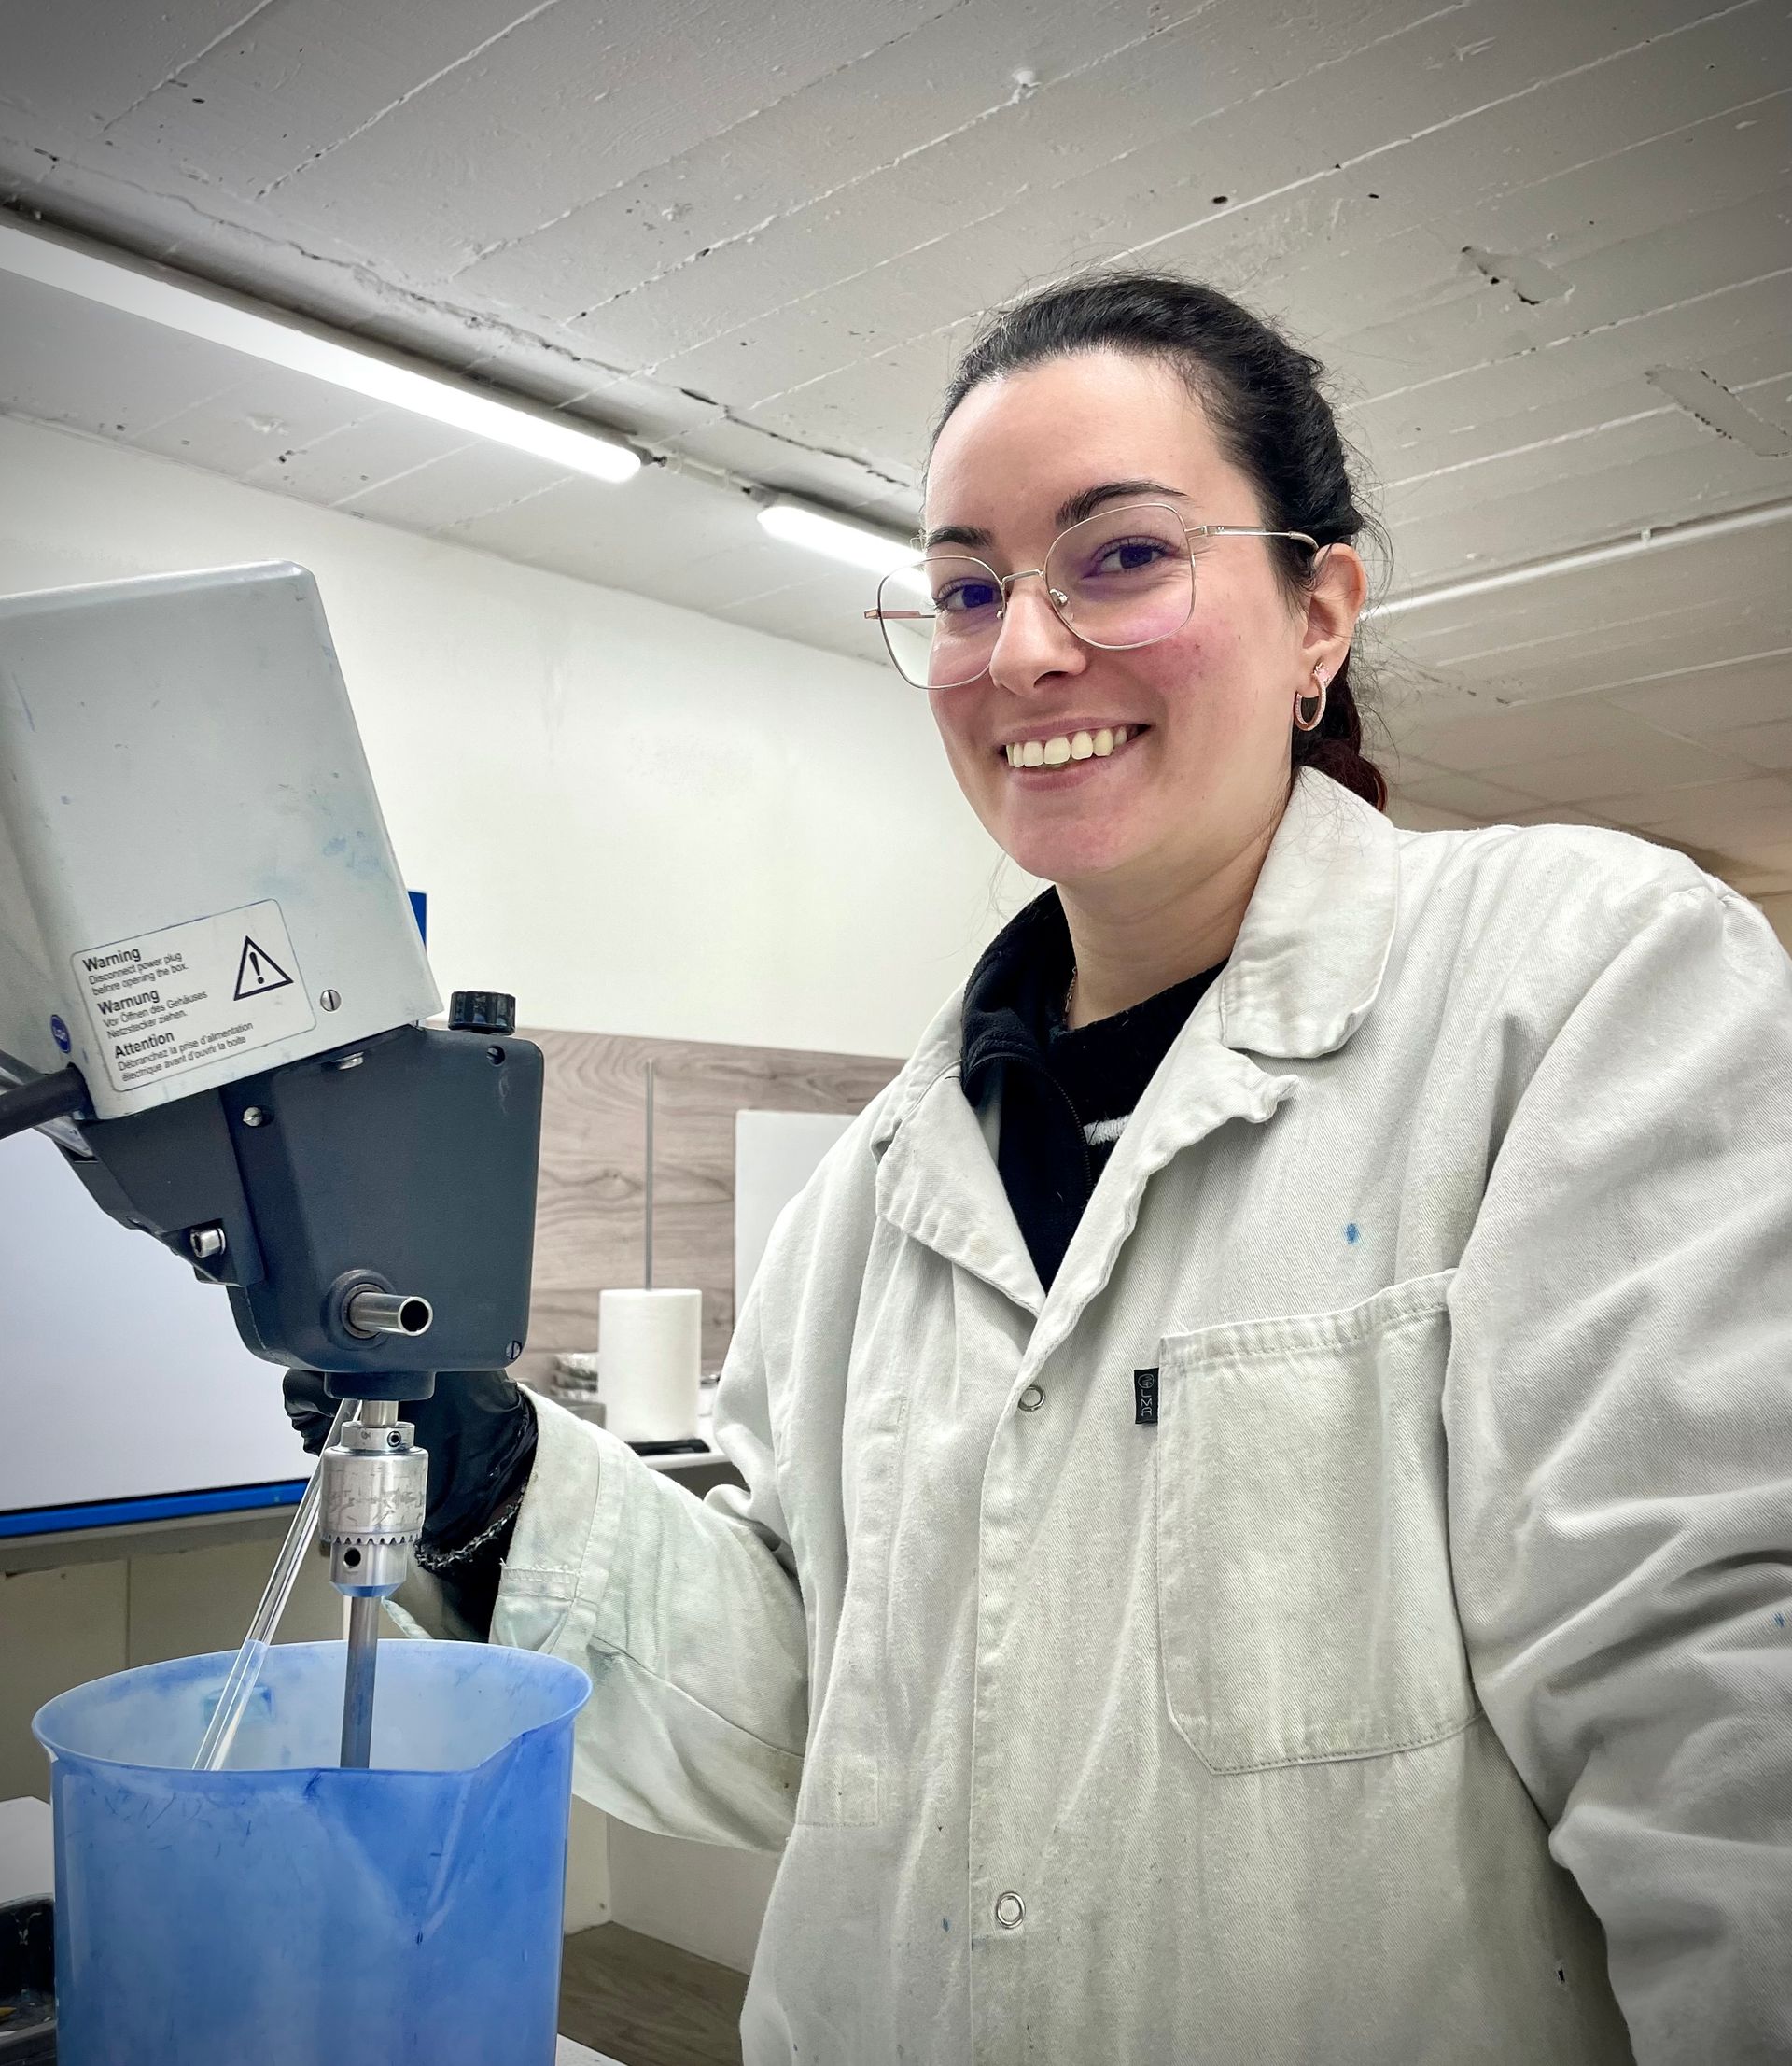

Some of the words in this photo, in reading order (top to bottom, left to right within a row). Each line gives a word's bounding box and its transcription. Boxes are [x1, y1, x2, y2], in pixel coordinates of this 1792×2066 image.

[82, 949, 141, 972] Warning
[88, 964, 135, 985] Disconnect
[137, 958, 162, 973] power
[163, 952, 182, 965] plug
[91, 982, 120, 996] before
[122, 972, 156, 988] opening
[156, 968, 170, 977] the
[170, 963, 189, 974] box.
[97, 990, 160, 1015] Warnung
[103, 1018, 119, 1028] Vor
[120, 1009, 148, 1022] Öffnen
[150, 1005, 165, 1014] des
[167, 991, 208, 1008] Gehäuses
[106, 1019, 156, 1039] Netzstecker
[170, 1046, 177, 1055] la
[179, 1039, 199, 1053] prise
[201, 1022, 254, 1045] d'alimentation
[114, 1032, 175, 1059] Attention
[164, 1055, 187, 1068] avant
[188, 1045, 217, 1061] d'ouvrir
[217, 1042, 226, 1050] la
